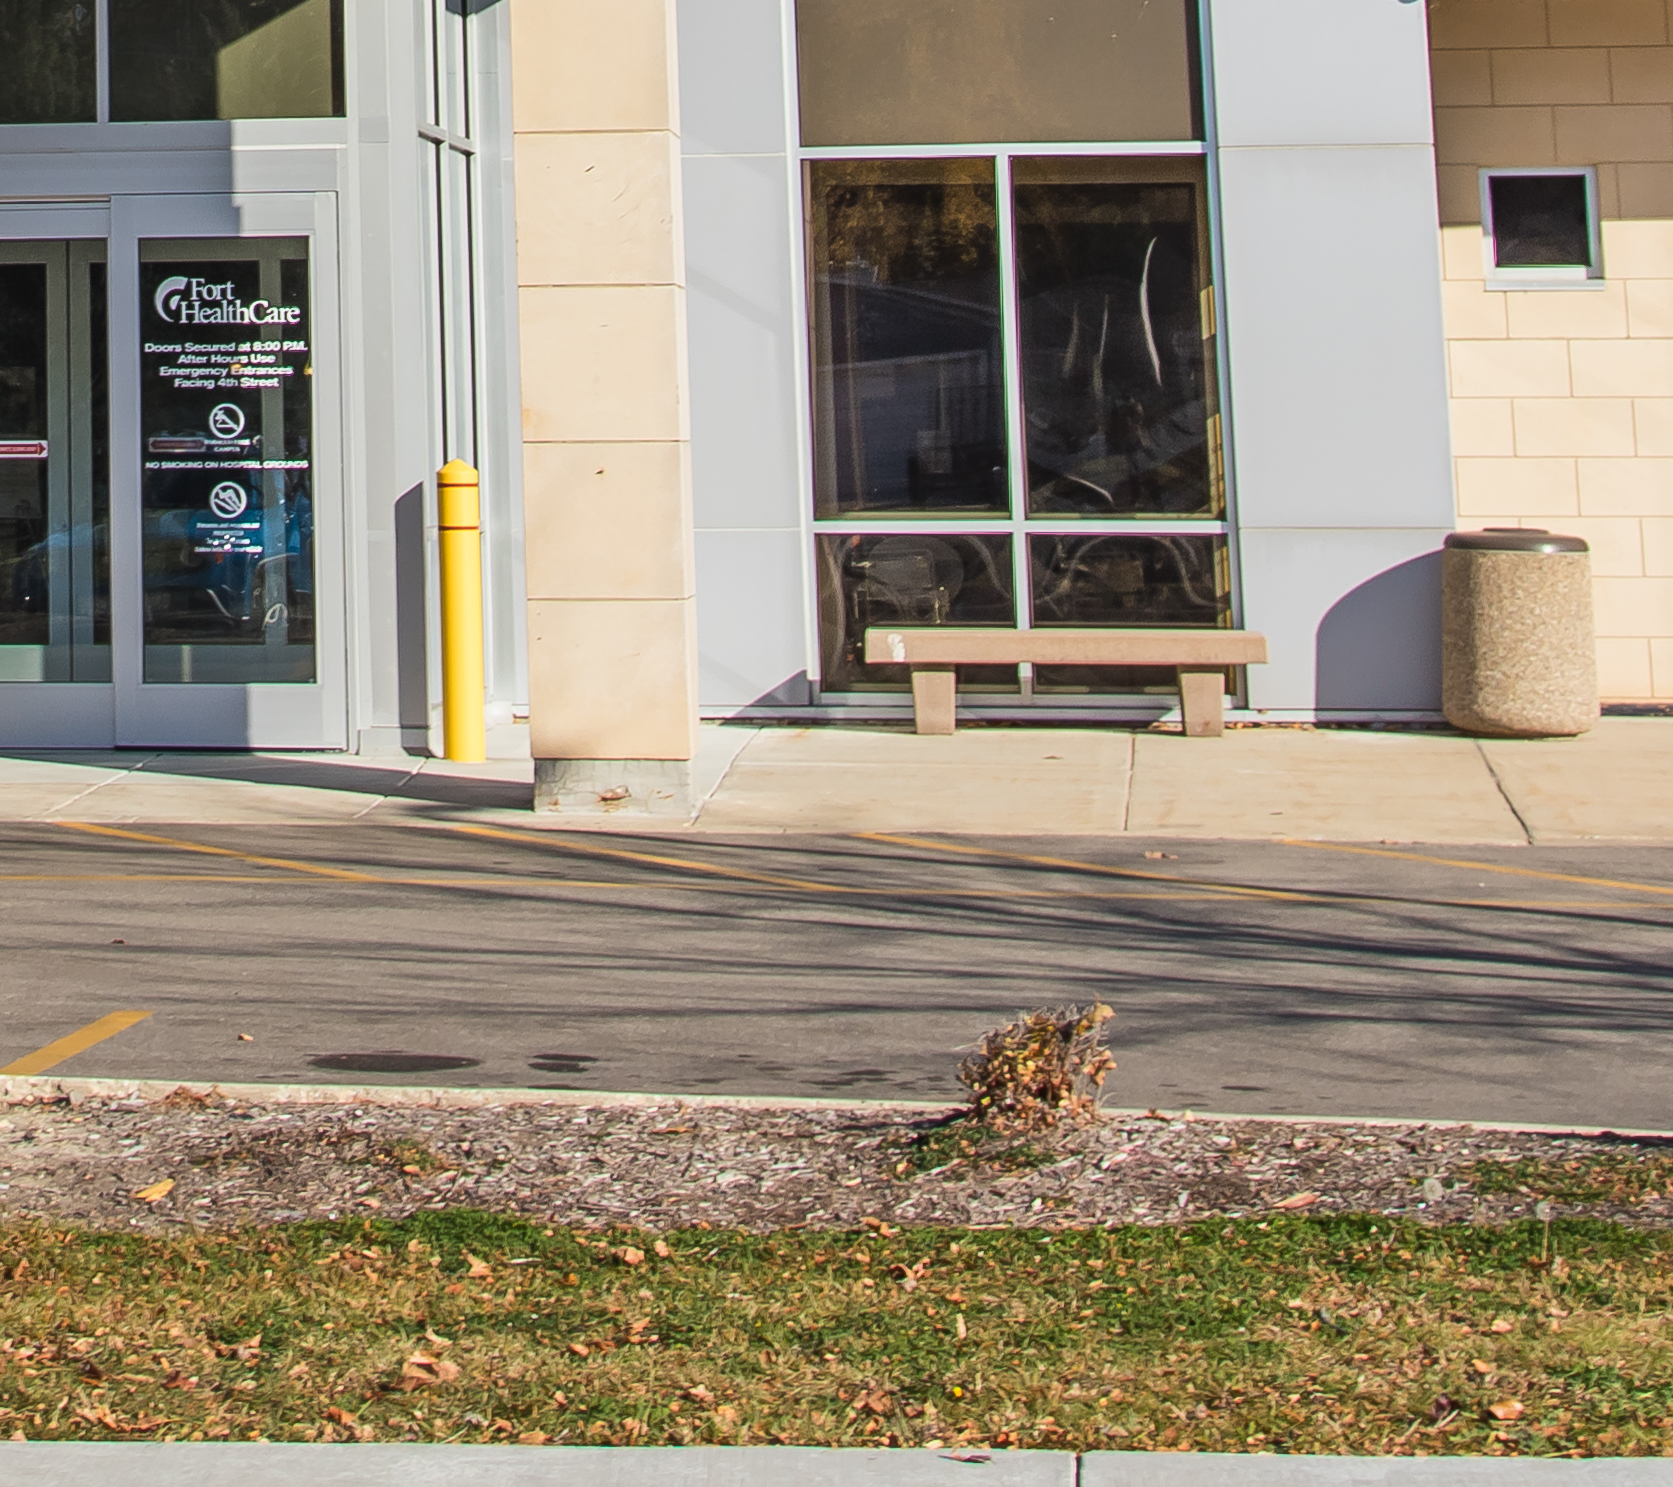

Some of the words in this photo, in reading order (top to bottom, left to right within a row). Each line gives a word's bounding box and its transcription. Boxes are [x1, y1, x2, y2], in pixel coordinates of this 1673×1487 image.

[189, 278, 235, 301] Fort
[179, 299, 301, 325] HealthCare
[144, 342, 182, 352] Doors
[184, 342, 236, 352] Secured
[237, 342, 251, 352] at
[177, 354, 208, 364] After
[210, 354, 249, 364] Hours
[250, 353, 276, 364] Use
[159, 366, 228, 378] Emergency
[230, 365, 294, 375] Entrances
[174, 378, 215, 389] Facing
[217, 378, 238, 387] 4th
[240, 377, 280, 388] Street
[145, 461, 160, 469] NO
[161, 461, 203, 469] SMOKING
[204, 461, 219, 469] ON
[220, 460, 263, 469] HOSPITAL
[263, 460, 309, 469] GROUNDS
